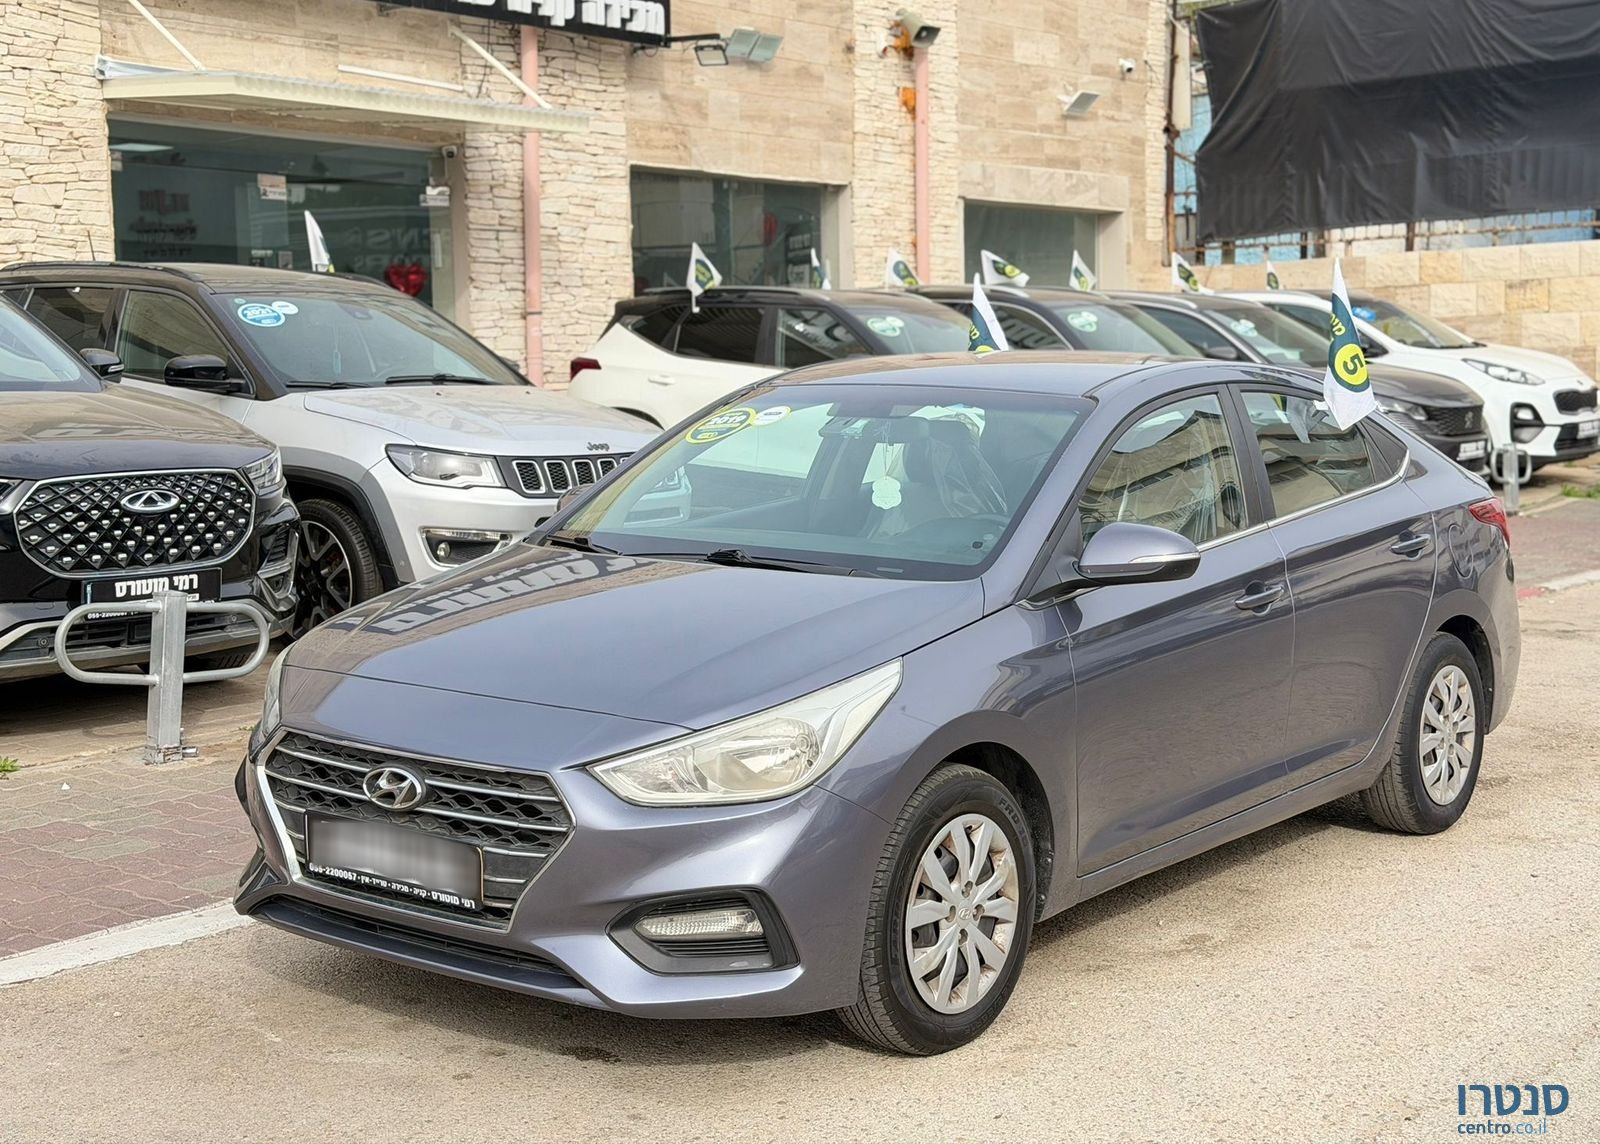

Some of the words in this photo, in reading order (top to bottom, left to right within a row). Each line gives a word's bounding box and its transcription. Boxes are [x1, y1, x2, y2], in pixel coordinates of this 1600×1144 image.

[1343, 353, 1364, 375] 5
[586, 441, 610, 452] Jeep
[114, 577, 169, 597] מוטורס
[173, 574, 198, 590] רמי
[309, 862, 357, 881] 055-2200057
[431, 890, 459, 905] מוטורס
[461, 897, 475, 909] רמי
